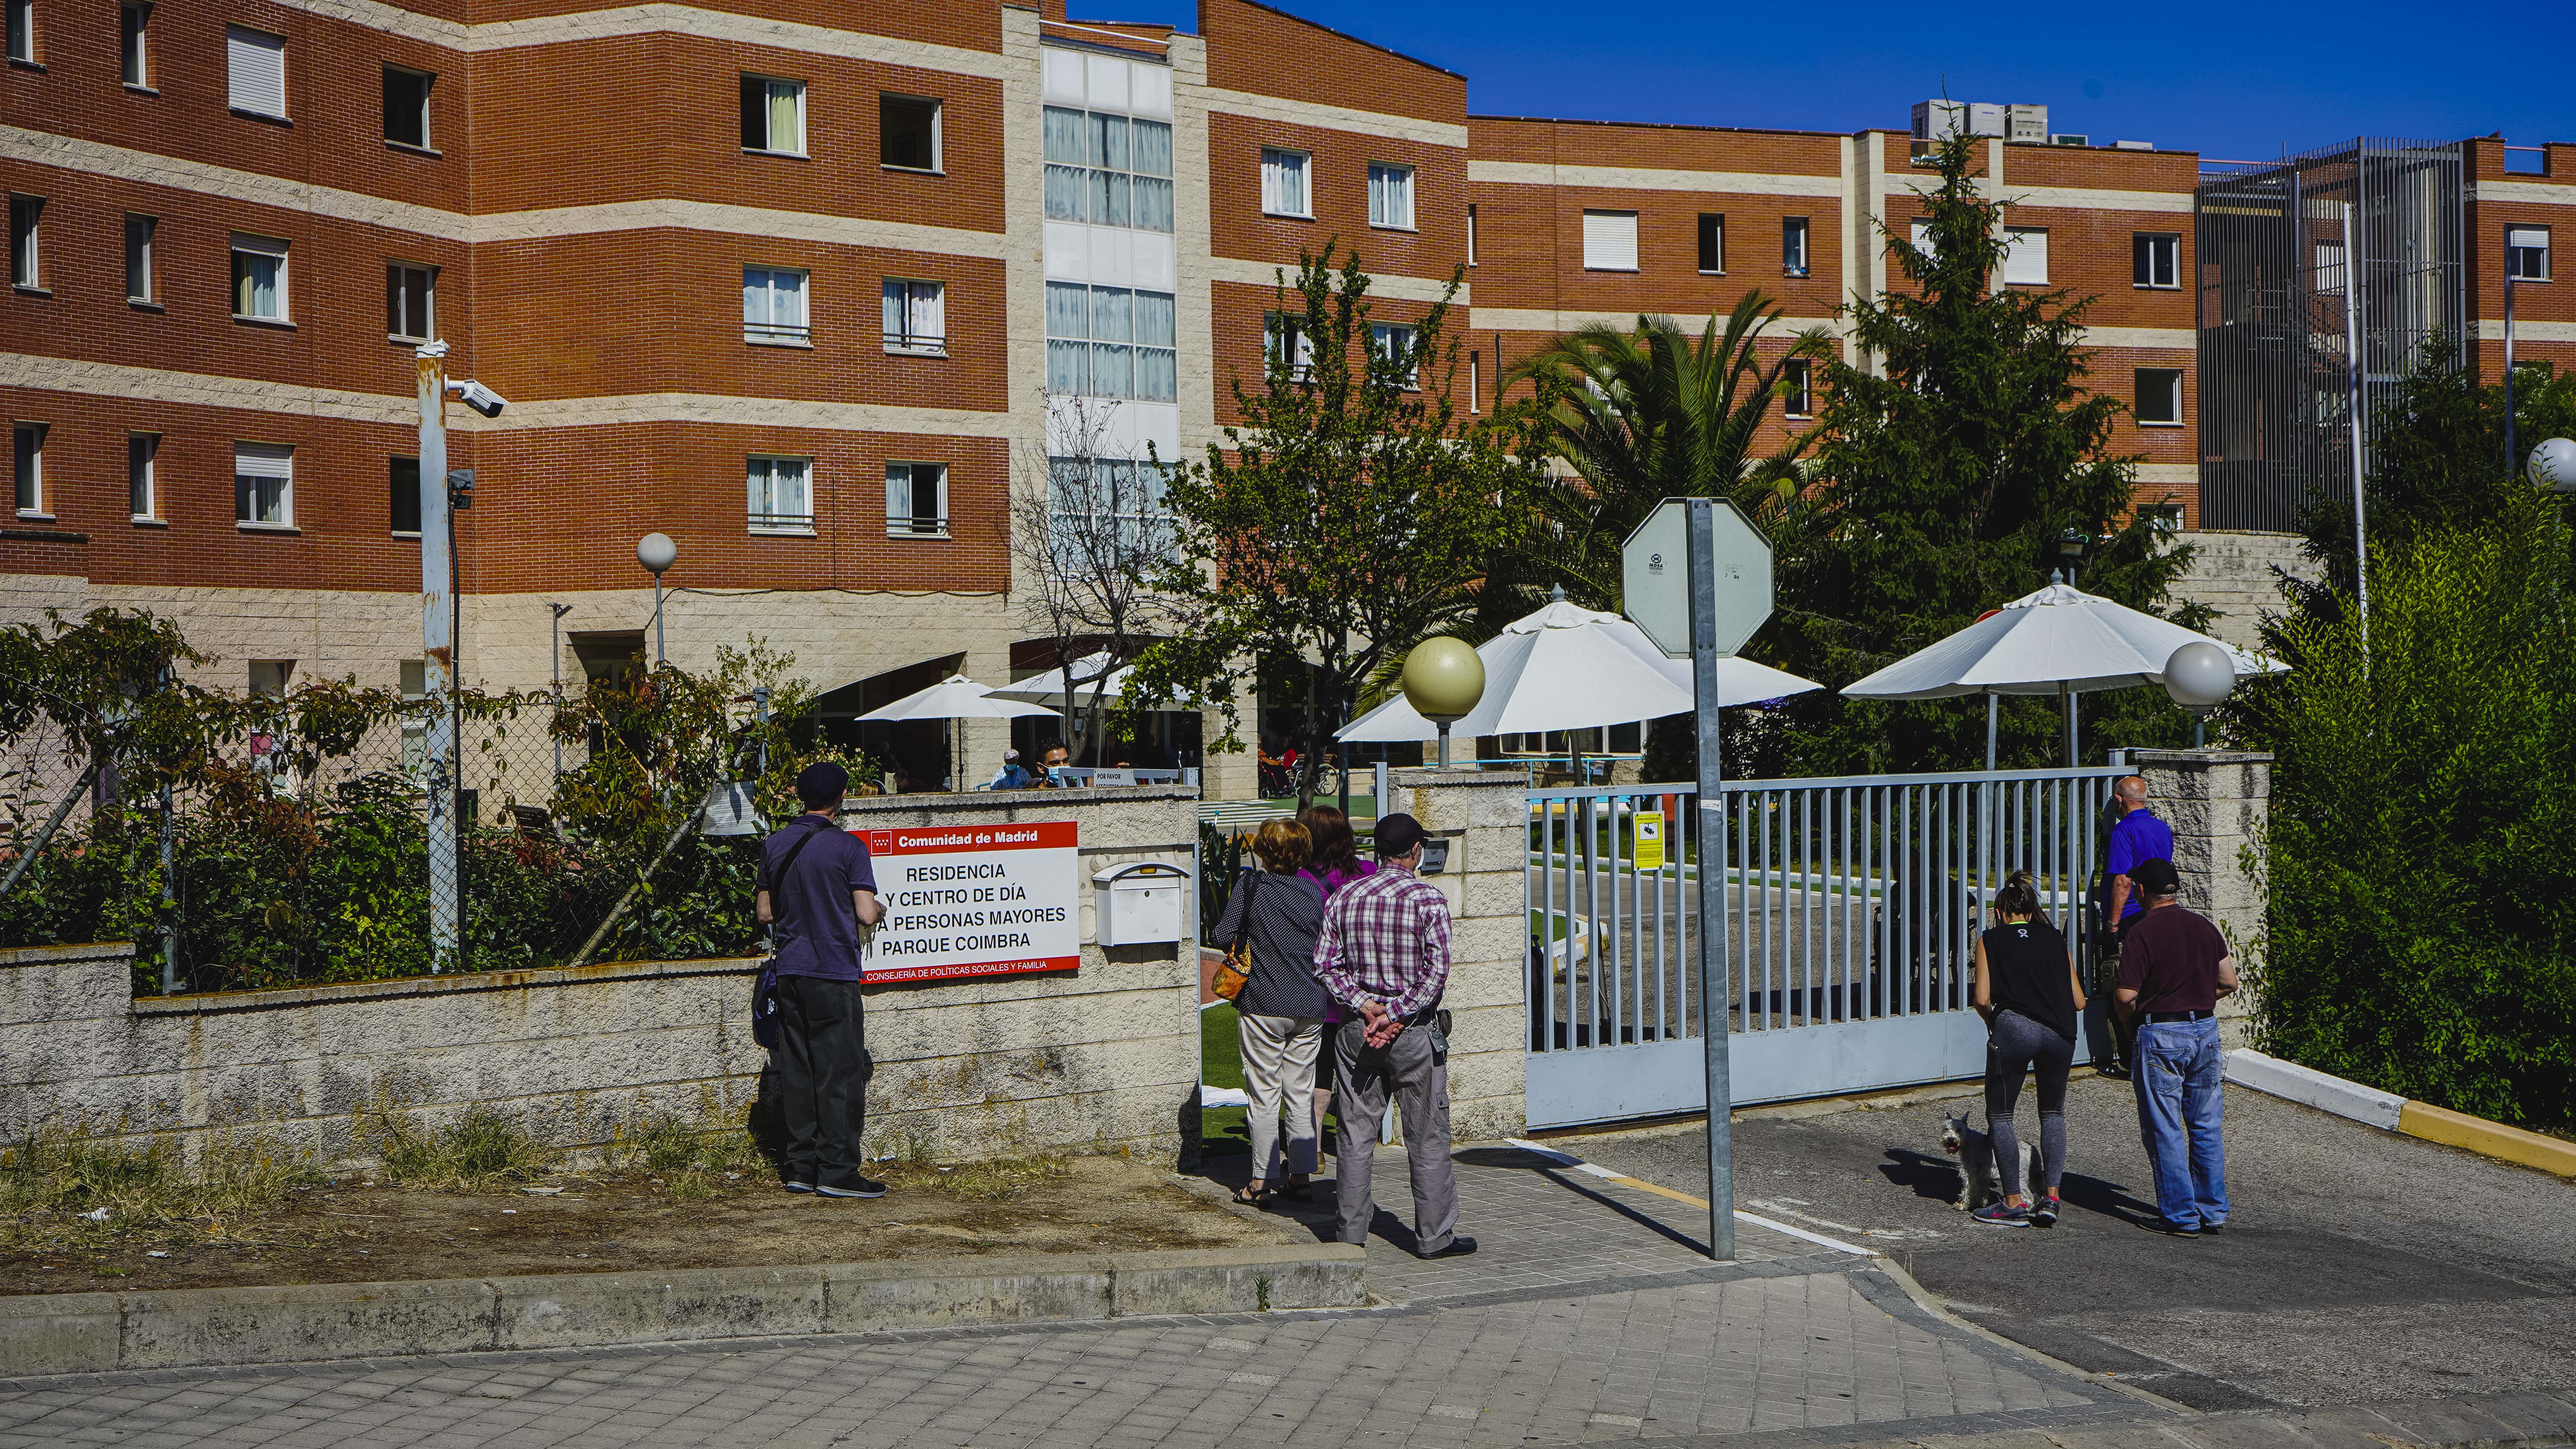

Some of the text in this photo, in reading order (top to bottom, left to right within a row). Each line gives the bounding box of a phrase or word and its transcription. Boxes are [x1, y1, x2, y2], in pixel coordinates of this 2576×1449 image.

[899, 830, 1038, 847] Comunidad de Madrid
[907, 864, 1005, 882] RESIDENCIA
[885, 882, 1026, 907] Y CENTRO DE DÍA
[894, 911, 984, 931] PERSONAS
[990, 907, 1065, 925] MAYORES
[883, 933, 1030, 956] PARQUE COIMBRA
[866, 969, 916, 981] CONSEJERÍA
[918, 969, 929, 977] DE
[930, 966, 970, 976] POLÍTICAS
[972, 963, 1009, 973] SOCIALES
[1018, 961, 1047, 970] FAMILIA
